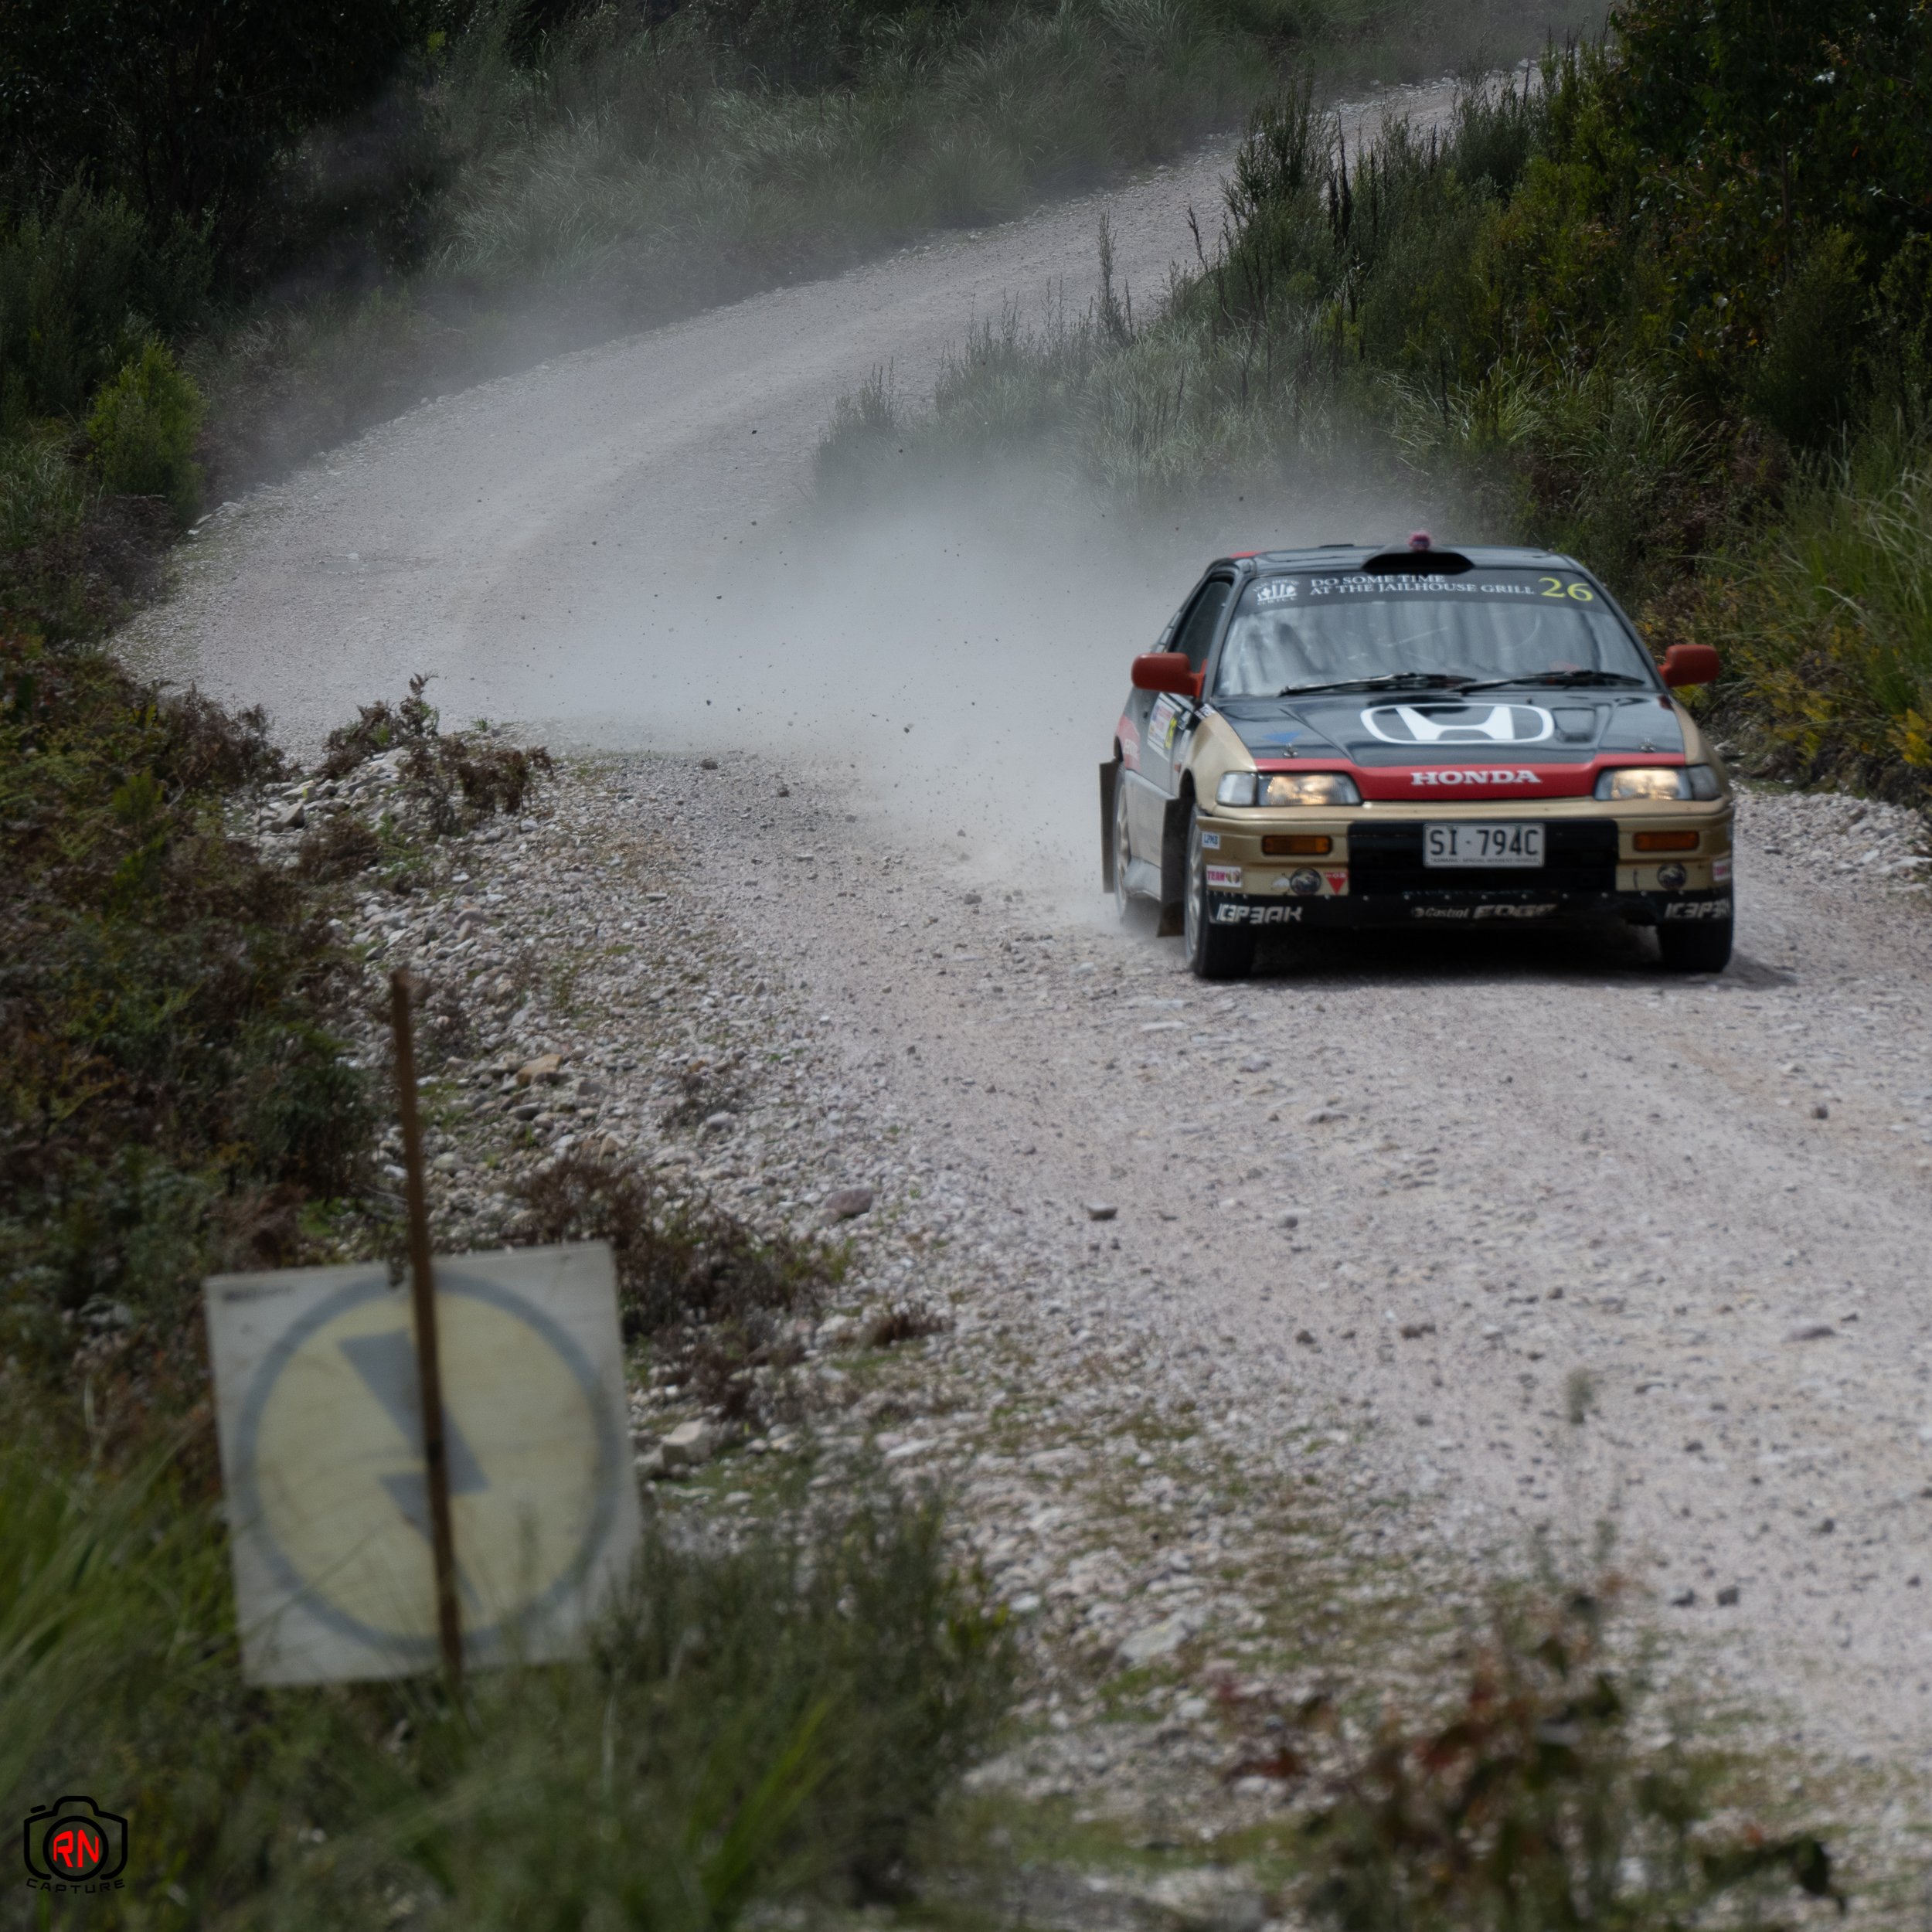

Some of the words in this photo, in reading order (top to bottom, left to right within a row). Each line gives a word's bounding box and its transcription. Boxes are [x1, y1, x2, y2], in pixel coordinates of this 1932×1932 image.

[1310, 585, 1330, 595] AT
[1335, 583, 1373, 594] THE
[1378, 582, 1477, 593] JAILHOUSE
[1481, 583, 1535, 594] GRILL
[1311, 579, 1338, 587] DO
[1343, 575, 1393, 585] SOME
[1397, 574, 1445, 583] TIME
[1538, 577, 1594, 601] 26
[1410, 770, 1543, 786] HONDA
[1426, 907, 1468, 919] Castrol
[1473, 904, 1557, 920] EDGE
